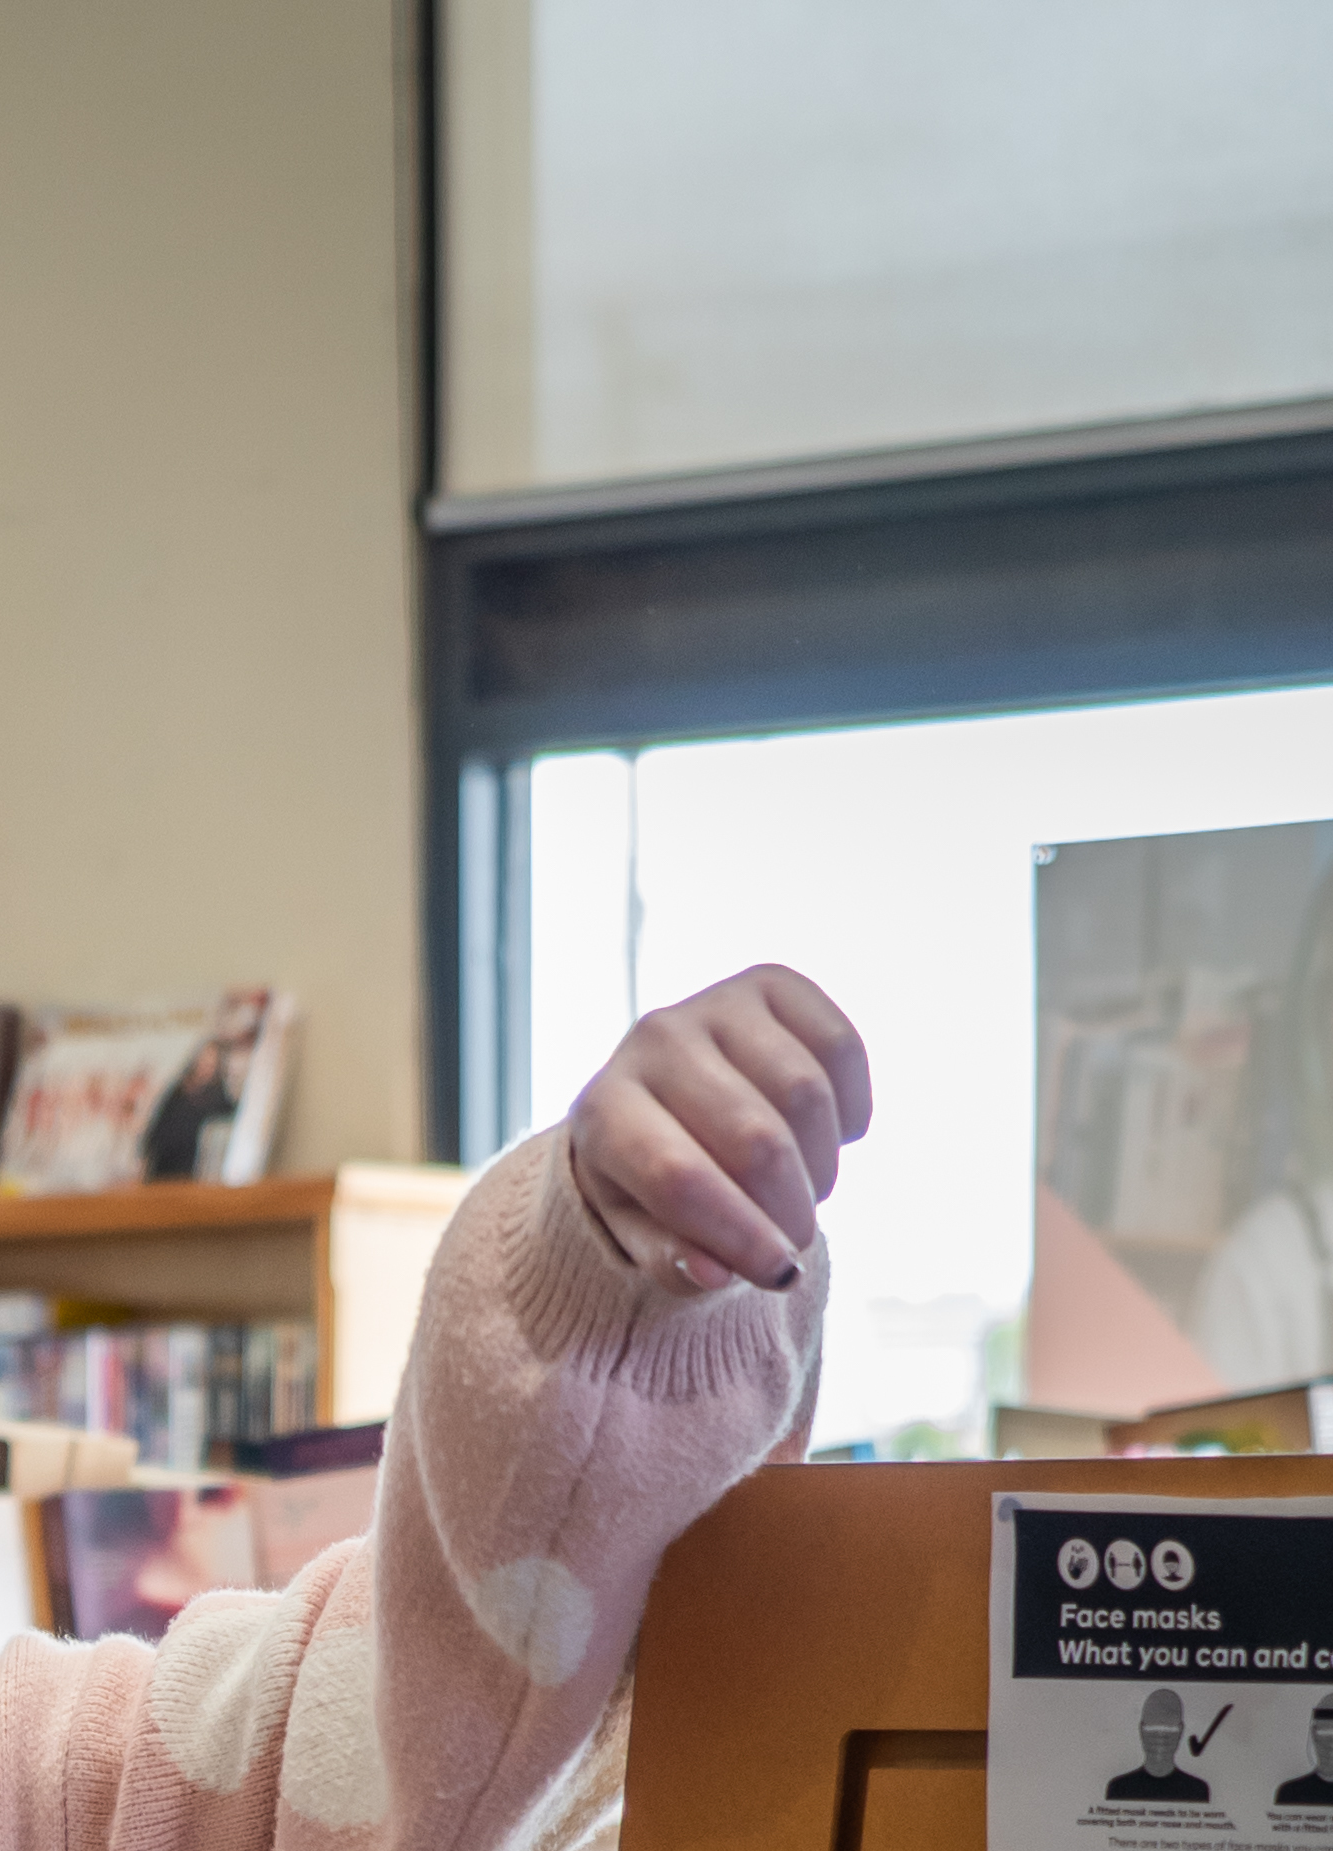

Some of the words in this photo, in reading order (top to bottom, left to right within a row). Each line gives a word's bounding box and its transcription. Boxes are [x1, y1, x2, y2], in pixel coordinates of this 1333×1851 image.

[1061, 1604, 1125, 1628] Face
[1133, 1603, 1221, 1630] masks
[1058, 1639, 1131, 1665] What
[1139, 1647, 1188, 1671] you
[1196, 1647, 1247, 1668] can
[1254, 1641, 1308, 1669] and
